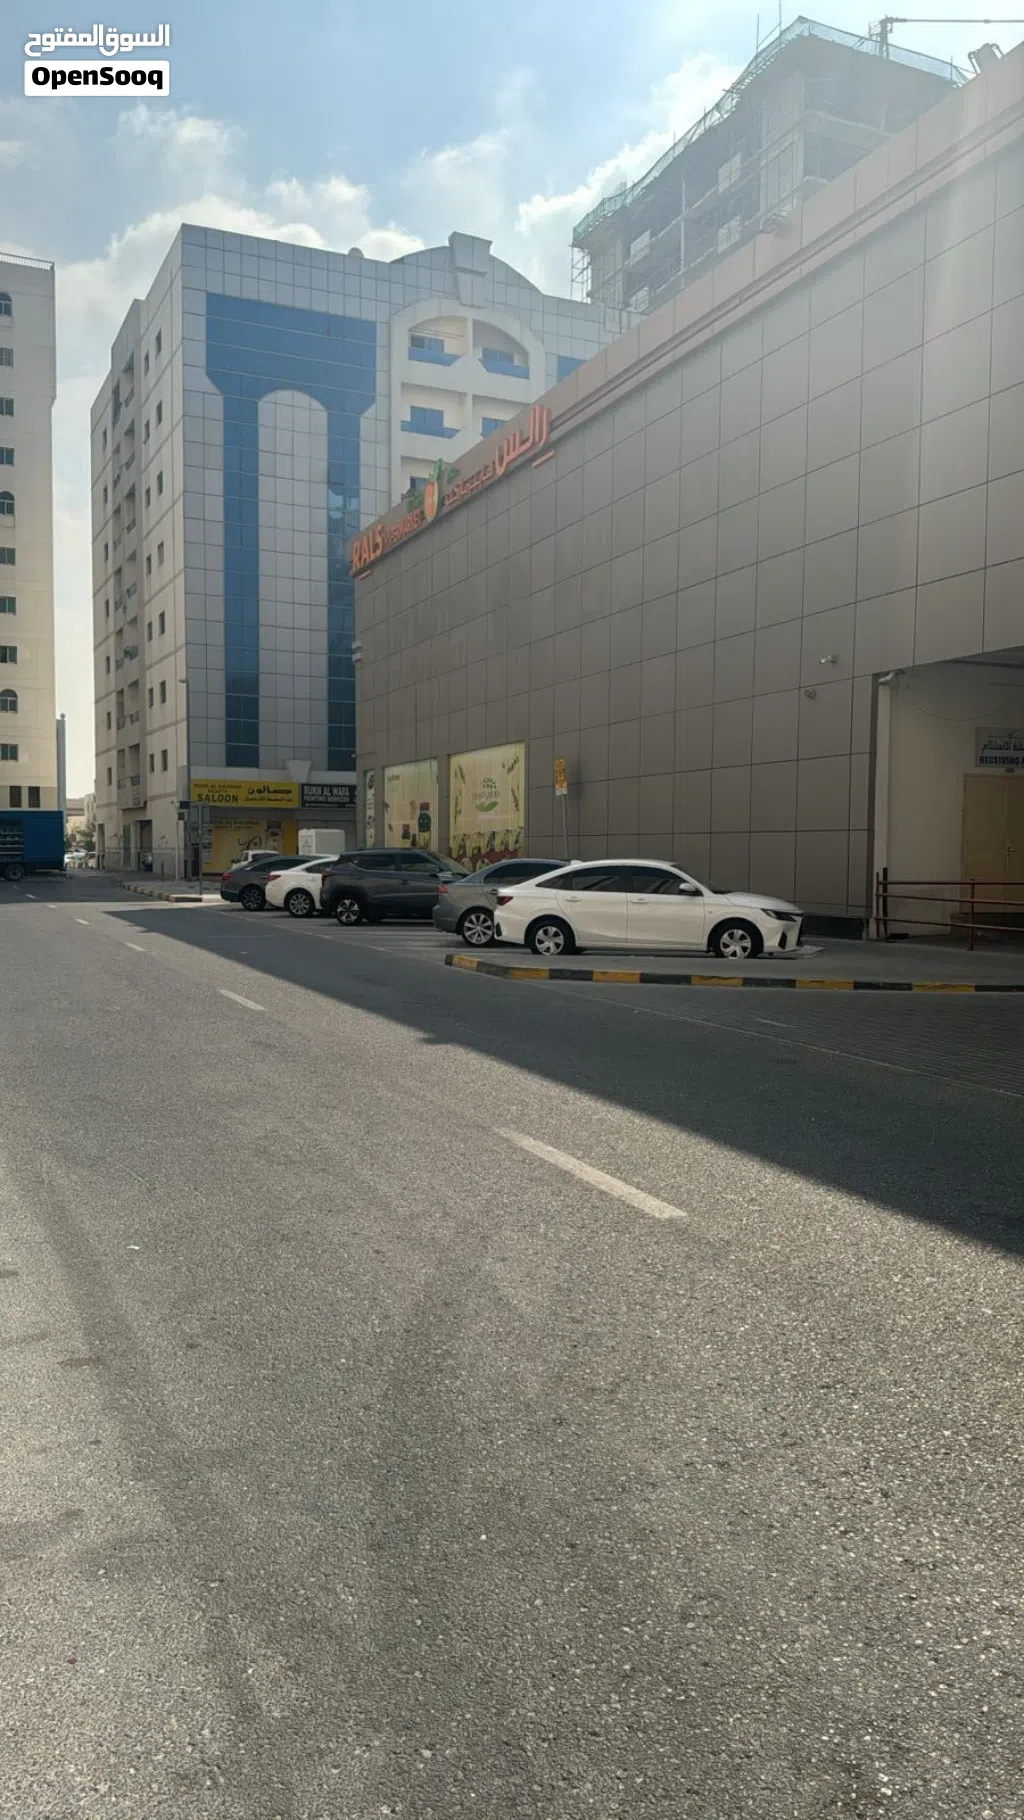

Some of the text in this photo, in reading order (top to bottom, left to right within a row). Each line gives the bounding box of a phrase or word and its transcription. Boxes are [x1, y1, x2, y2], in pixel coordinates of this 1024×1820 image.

[352, 524, 384, 571] RALS
[979, 755, 1020, 765] RECEIVING
[247, 784, 292, 795] سالون
[197, 793, 239, 803] SALOON
